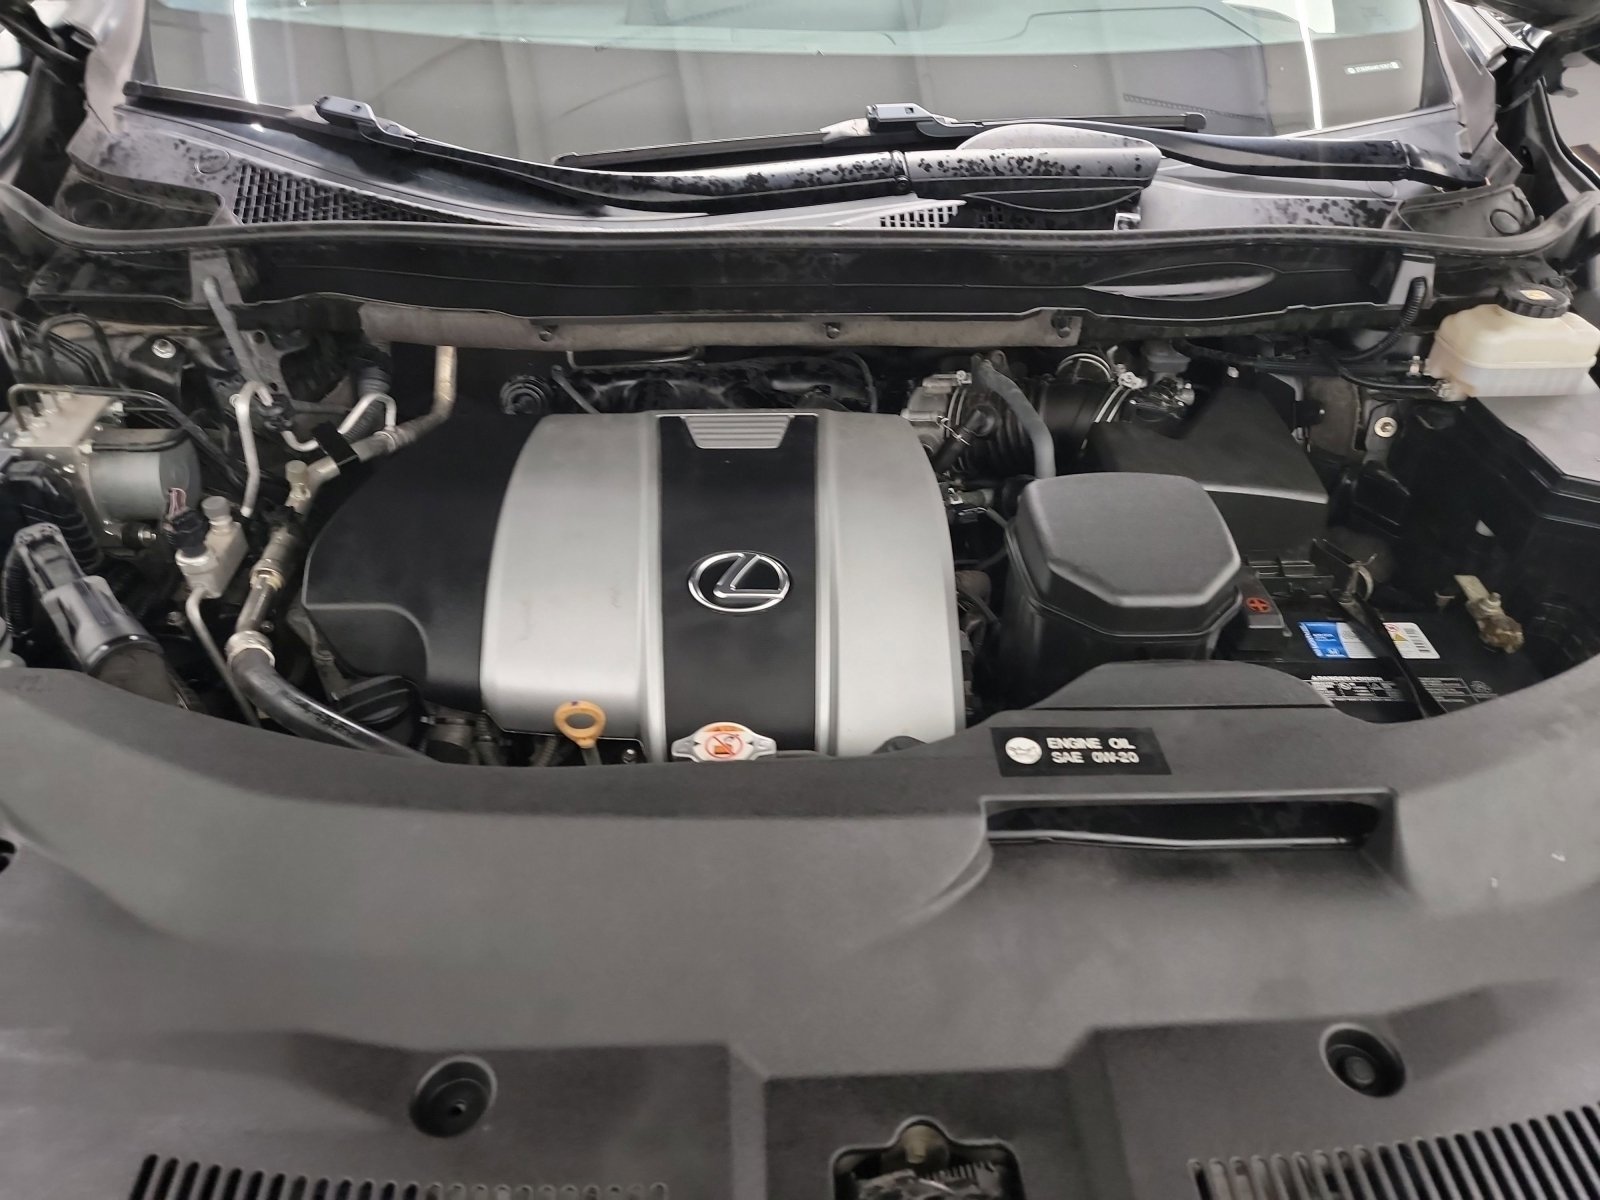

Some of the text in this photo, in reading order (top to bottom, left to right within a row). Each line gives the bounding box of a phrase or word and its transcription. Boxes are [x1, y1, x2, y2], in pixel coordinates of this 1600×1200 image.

[1046, 737, 1136, 749] ENGINE OIL
[1051, 751, 1140, 763] SAE 0W-20
